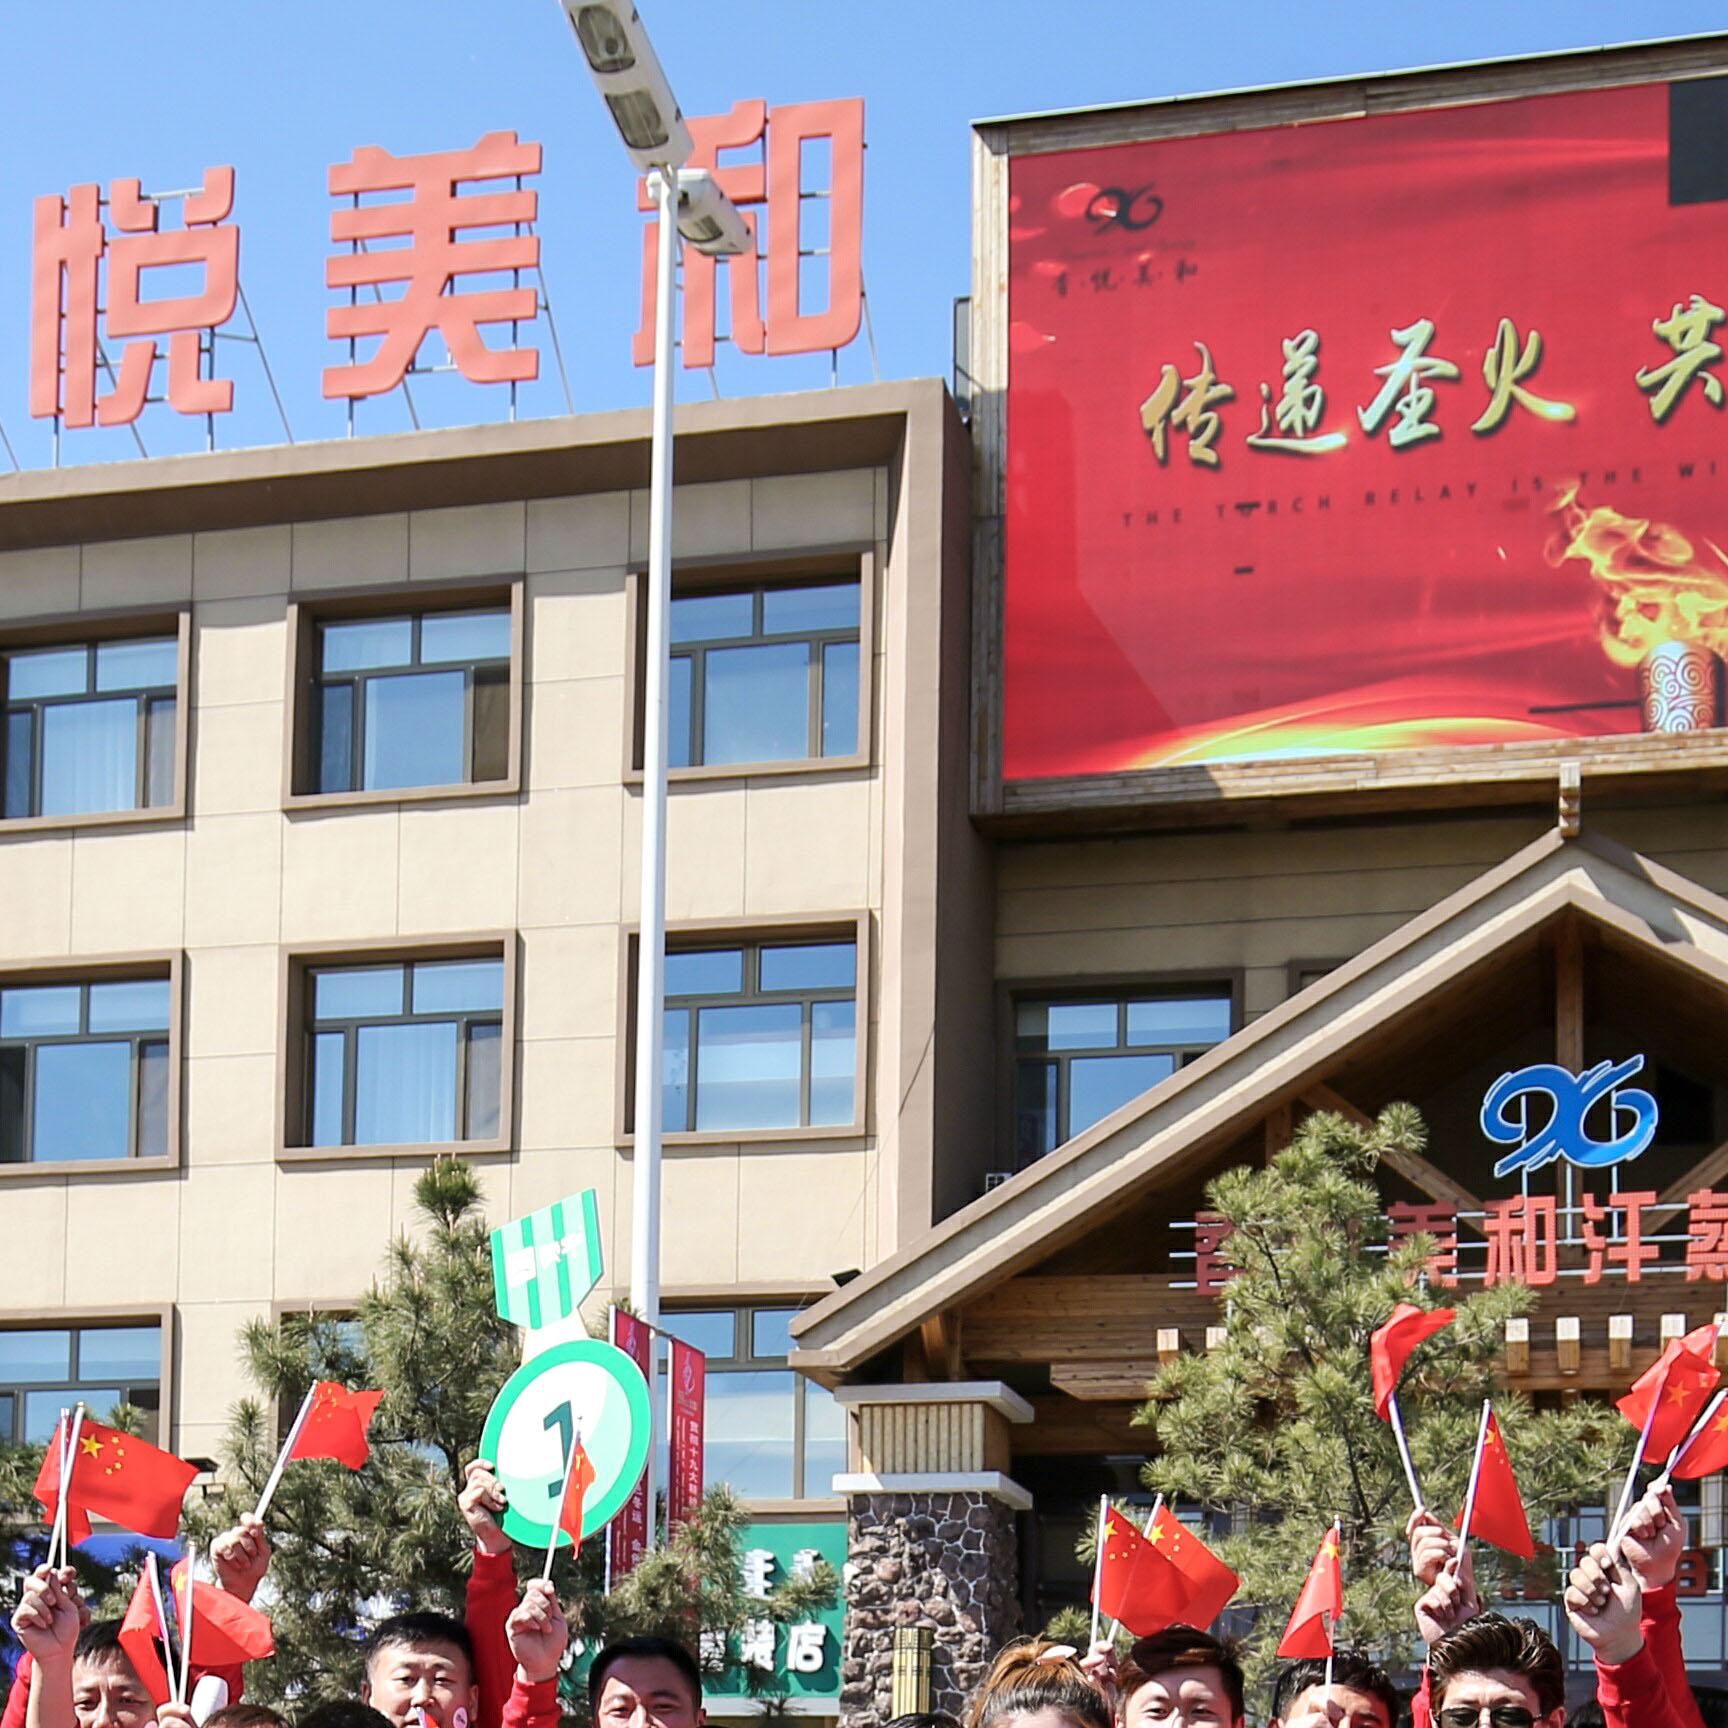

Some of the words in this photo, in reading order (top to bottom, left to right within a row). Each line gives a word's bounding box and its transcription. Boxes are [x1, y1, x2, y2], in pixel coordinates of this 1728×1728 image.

[1139, 316, 1576, 467] 传递圣火
[1122, 510, 1184, 527] THE
[1577, 467, 1643, 488] THE
